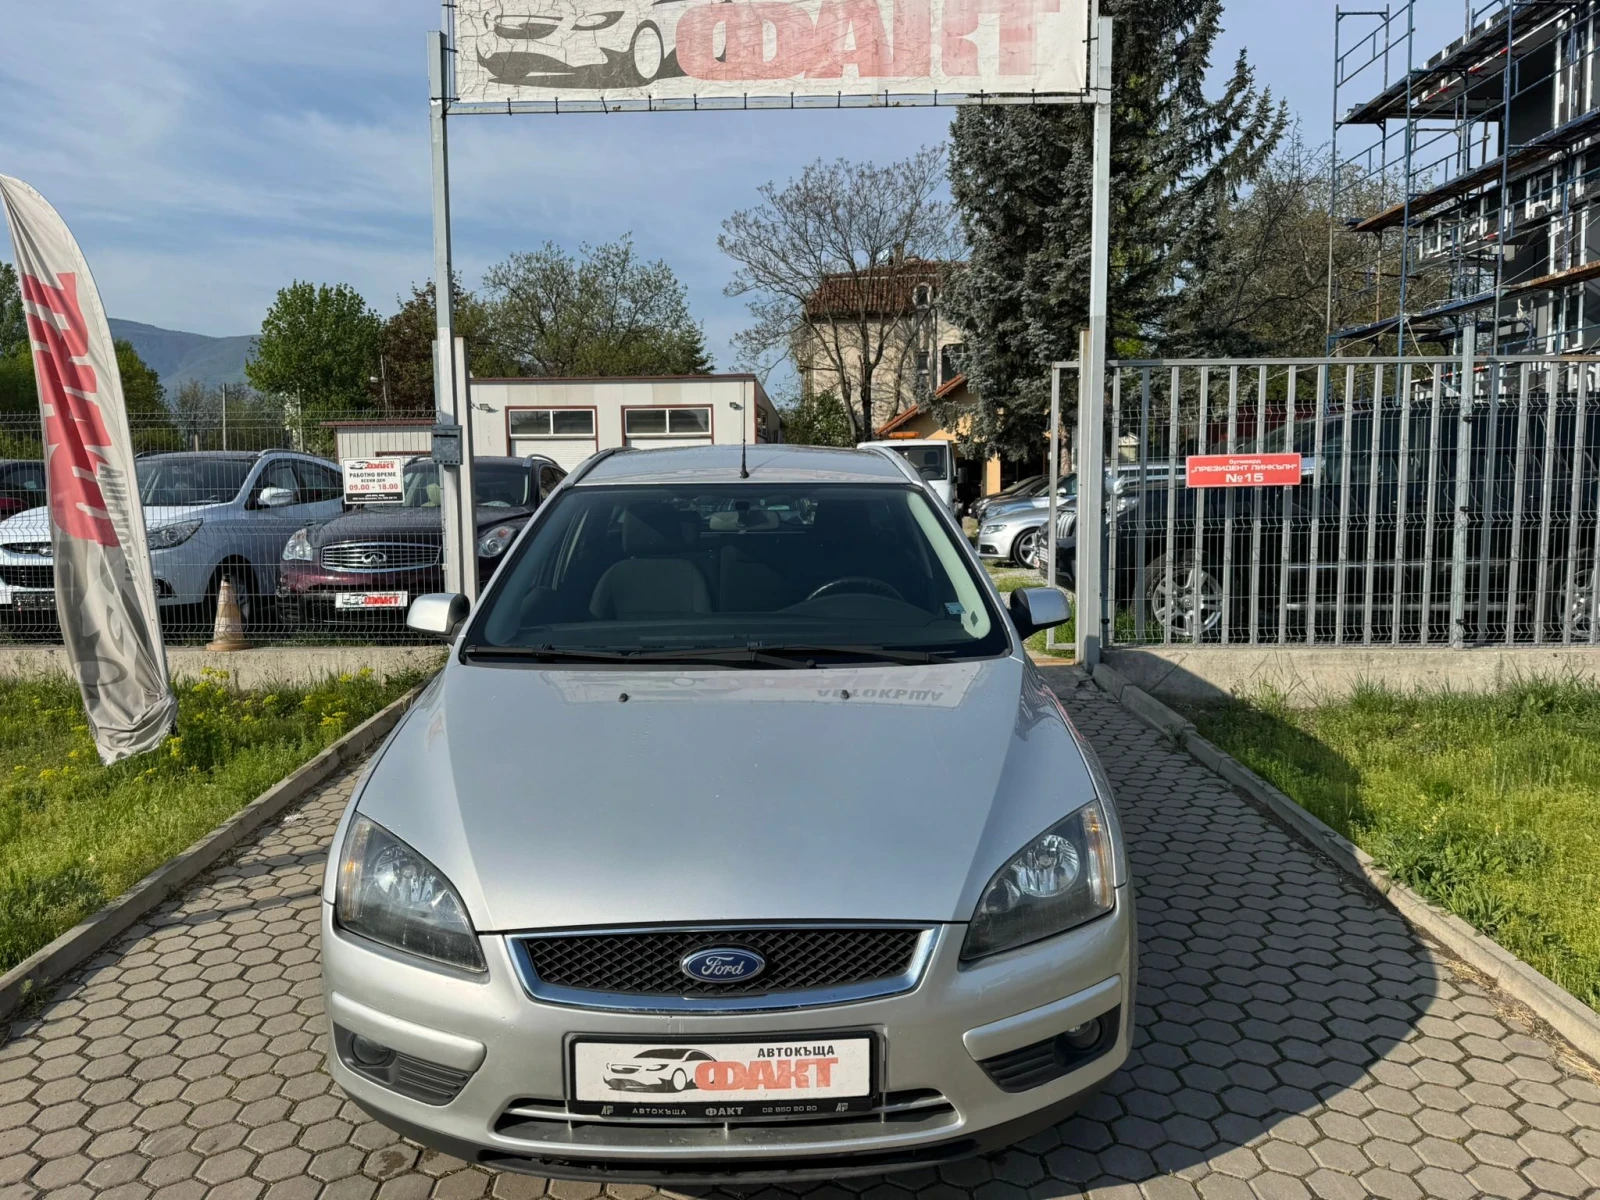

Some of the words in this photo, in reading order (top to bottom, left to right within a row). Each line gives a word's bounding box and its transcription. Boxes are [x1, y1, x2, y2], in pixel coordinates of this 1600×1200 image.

[675, 0, 1060, 80] ФАКТ
[701, 956, 745, 975] Ford
[757, 1045, 835, 1058] АВТОКЪЩА
[695, 1057, 839, 1091] ФАКТ
[705, 1107, 744, 1116] ФАКТ
